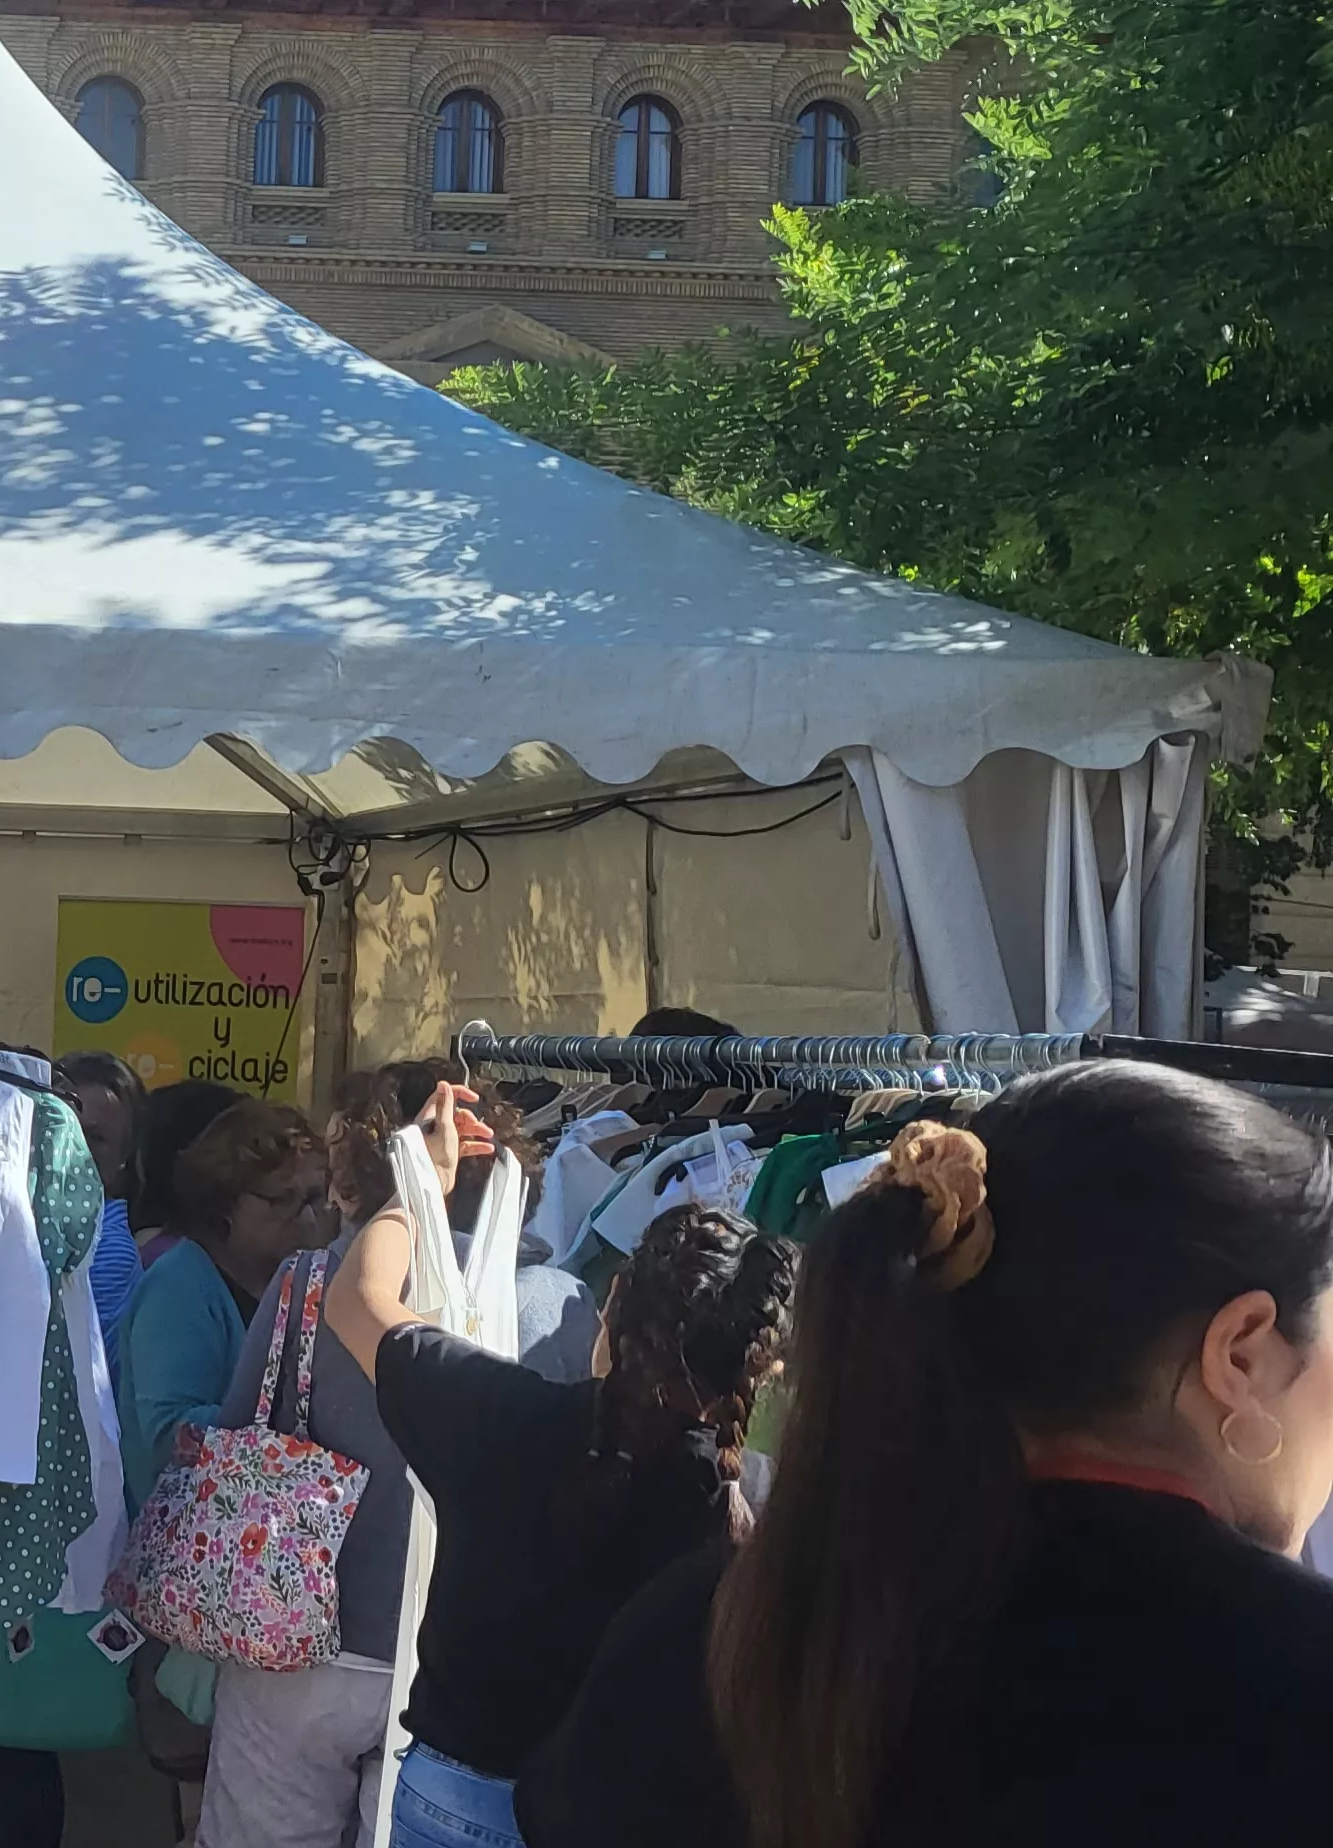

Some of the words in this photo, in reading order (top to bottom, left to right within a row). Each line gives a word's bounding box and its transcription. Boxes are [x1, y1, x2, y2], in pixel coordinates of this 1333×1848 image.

[134, 972, 290, 1010] utilización
[213, 1016, 232, 1048] y
[188, 1049, 289, 1090] ciclaje
